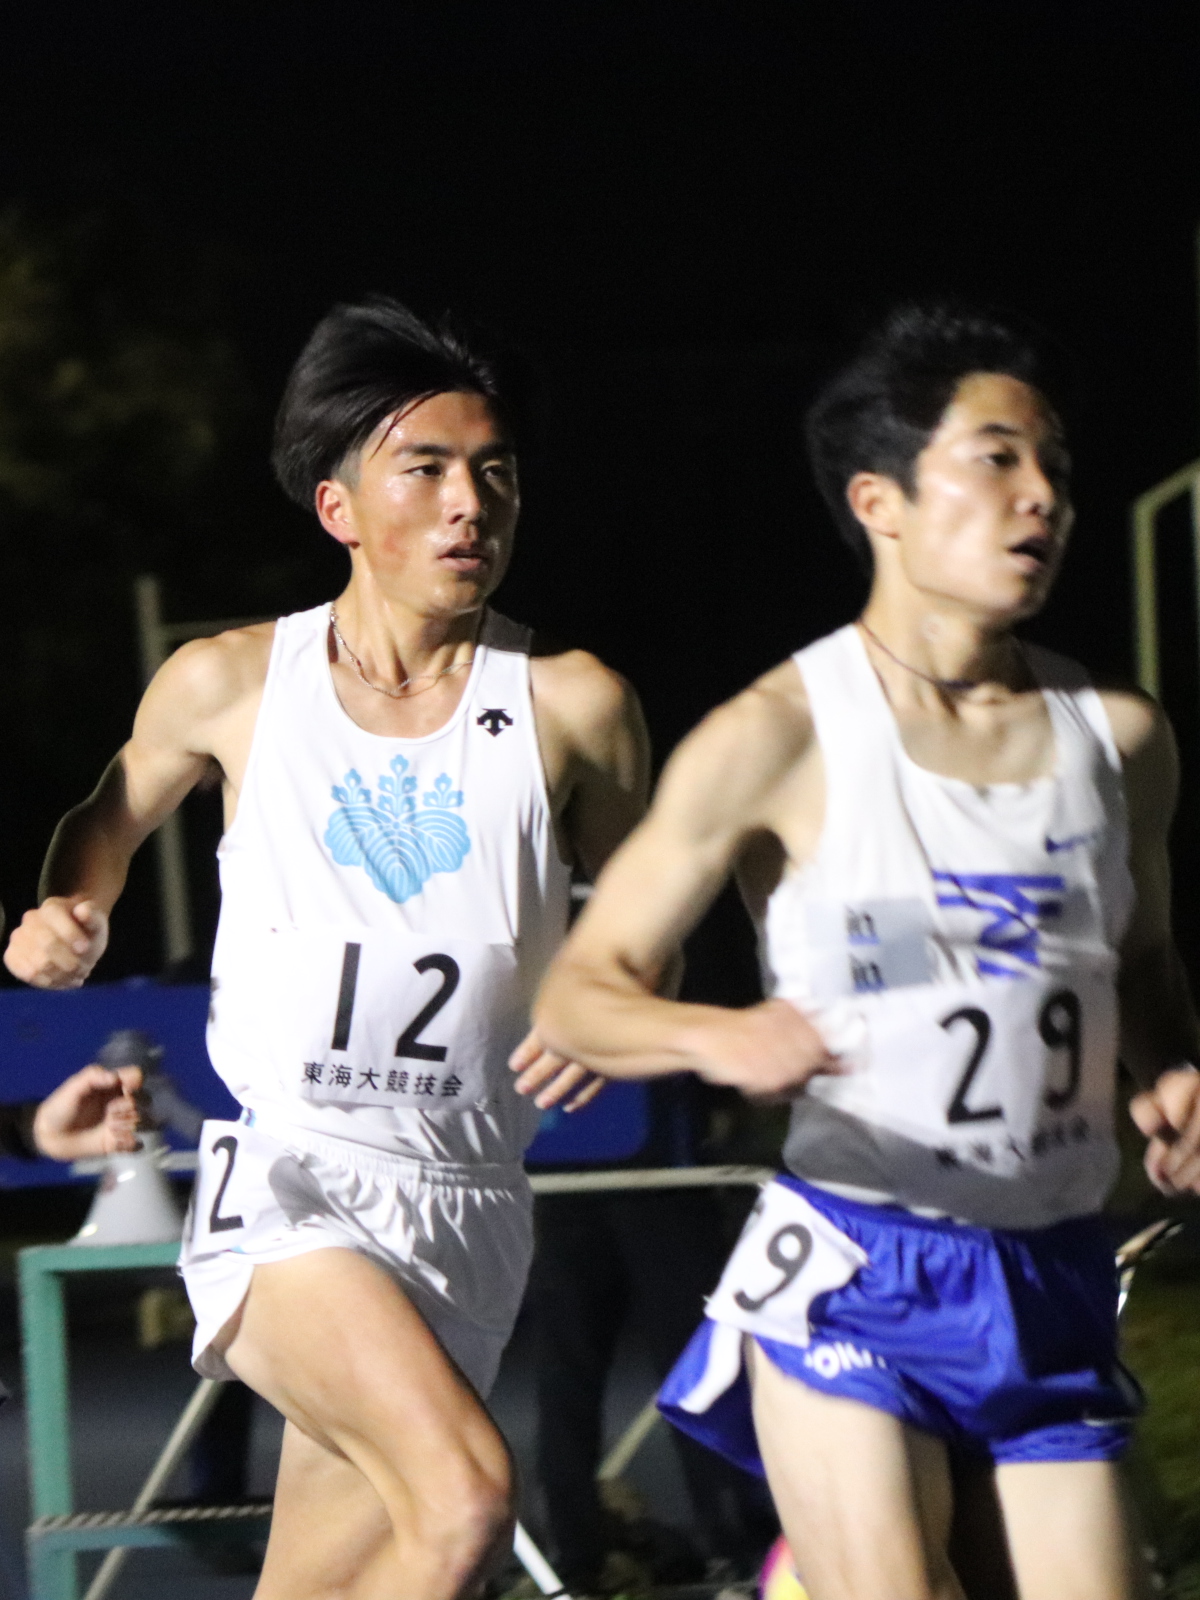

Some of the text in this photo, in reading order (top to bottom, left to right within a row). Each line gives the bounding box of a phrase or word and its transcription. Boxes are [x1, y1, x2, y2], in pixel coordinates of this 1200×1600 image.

[331, 941, 461, 1062] 12
[301, 1061, 464, 1098] 東海大競技会
[940, 988, 1083, 1125] 29
[735, 1223, 813, 1311] 9
